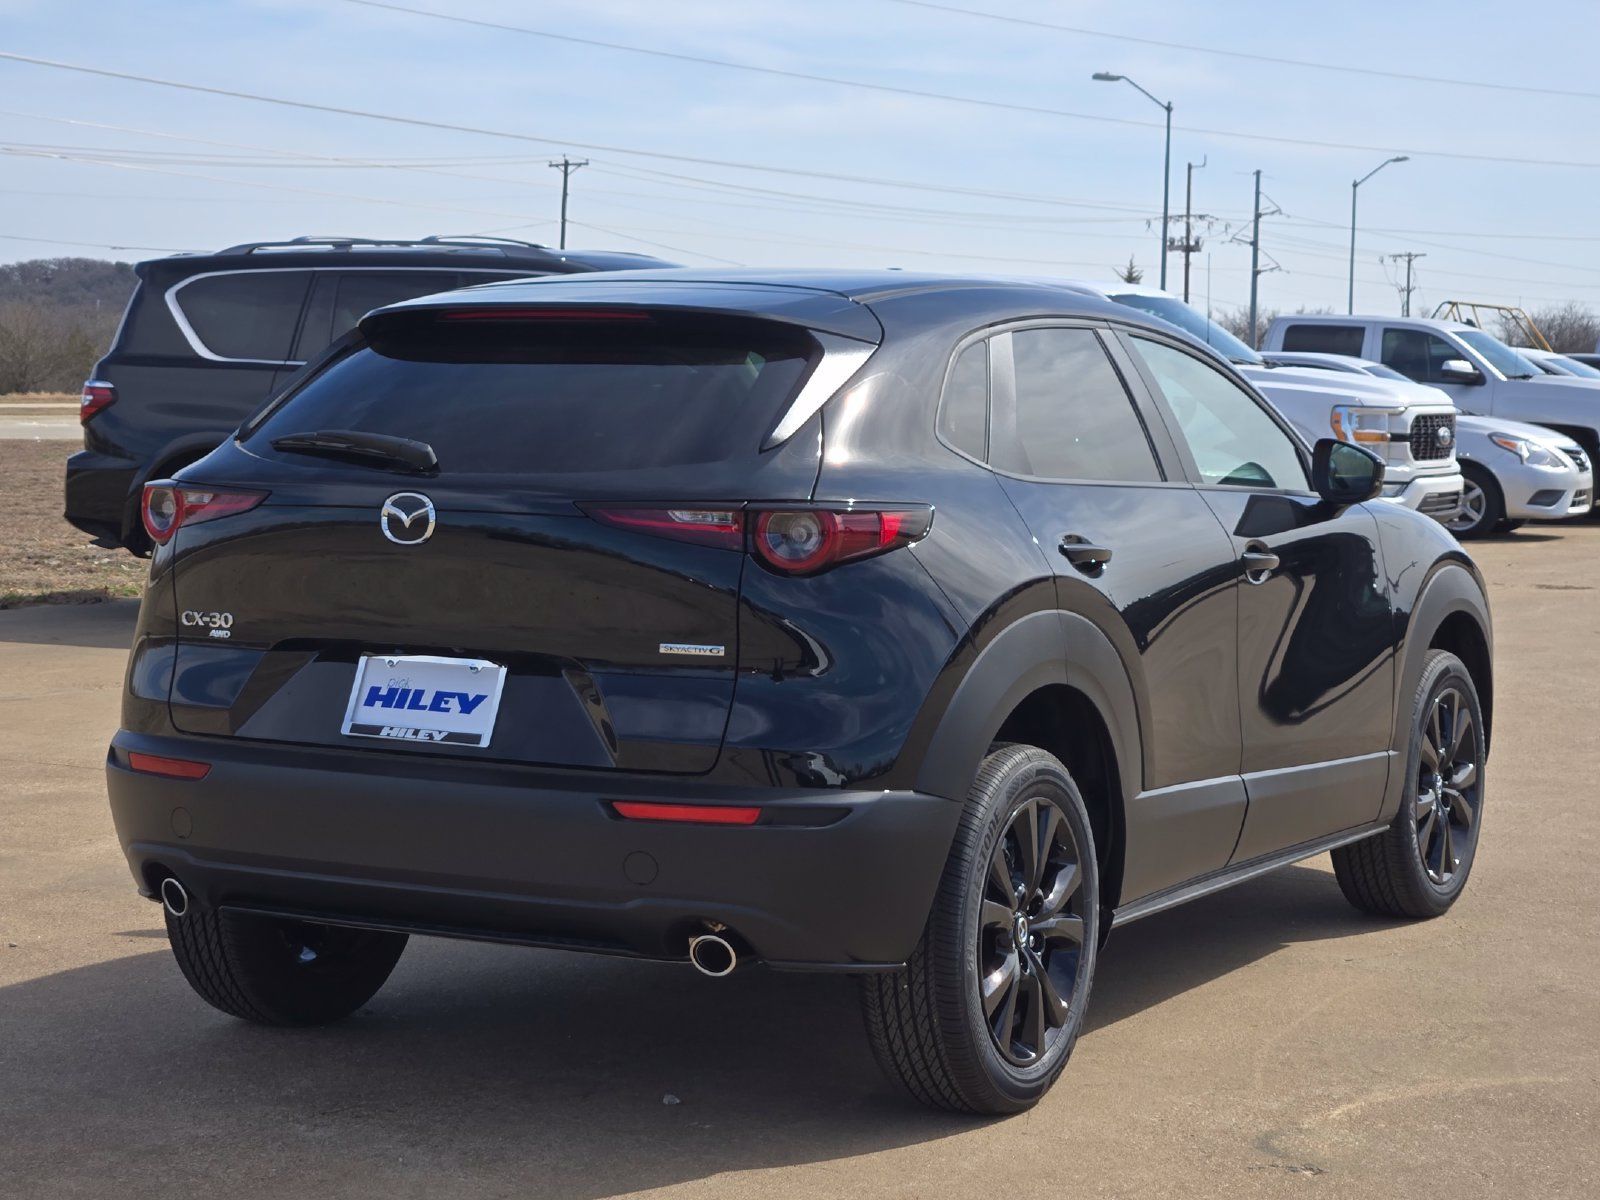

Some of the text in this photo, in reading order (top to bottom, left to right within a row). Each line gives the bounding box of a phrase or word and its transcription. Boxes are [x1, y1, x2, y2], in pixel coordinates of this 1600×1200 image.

[181, 610, 234, 628] CX-30
[209, 629, 231, 638] AWD
[363, 686, 488, 714] HILEY
[379, 726, 449, 741] HILEY
